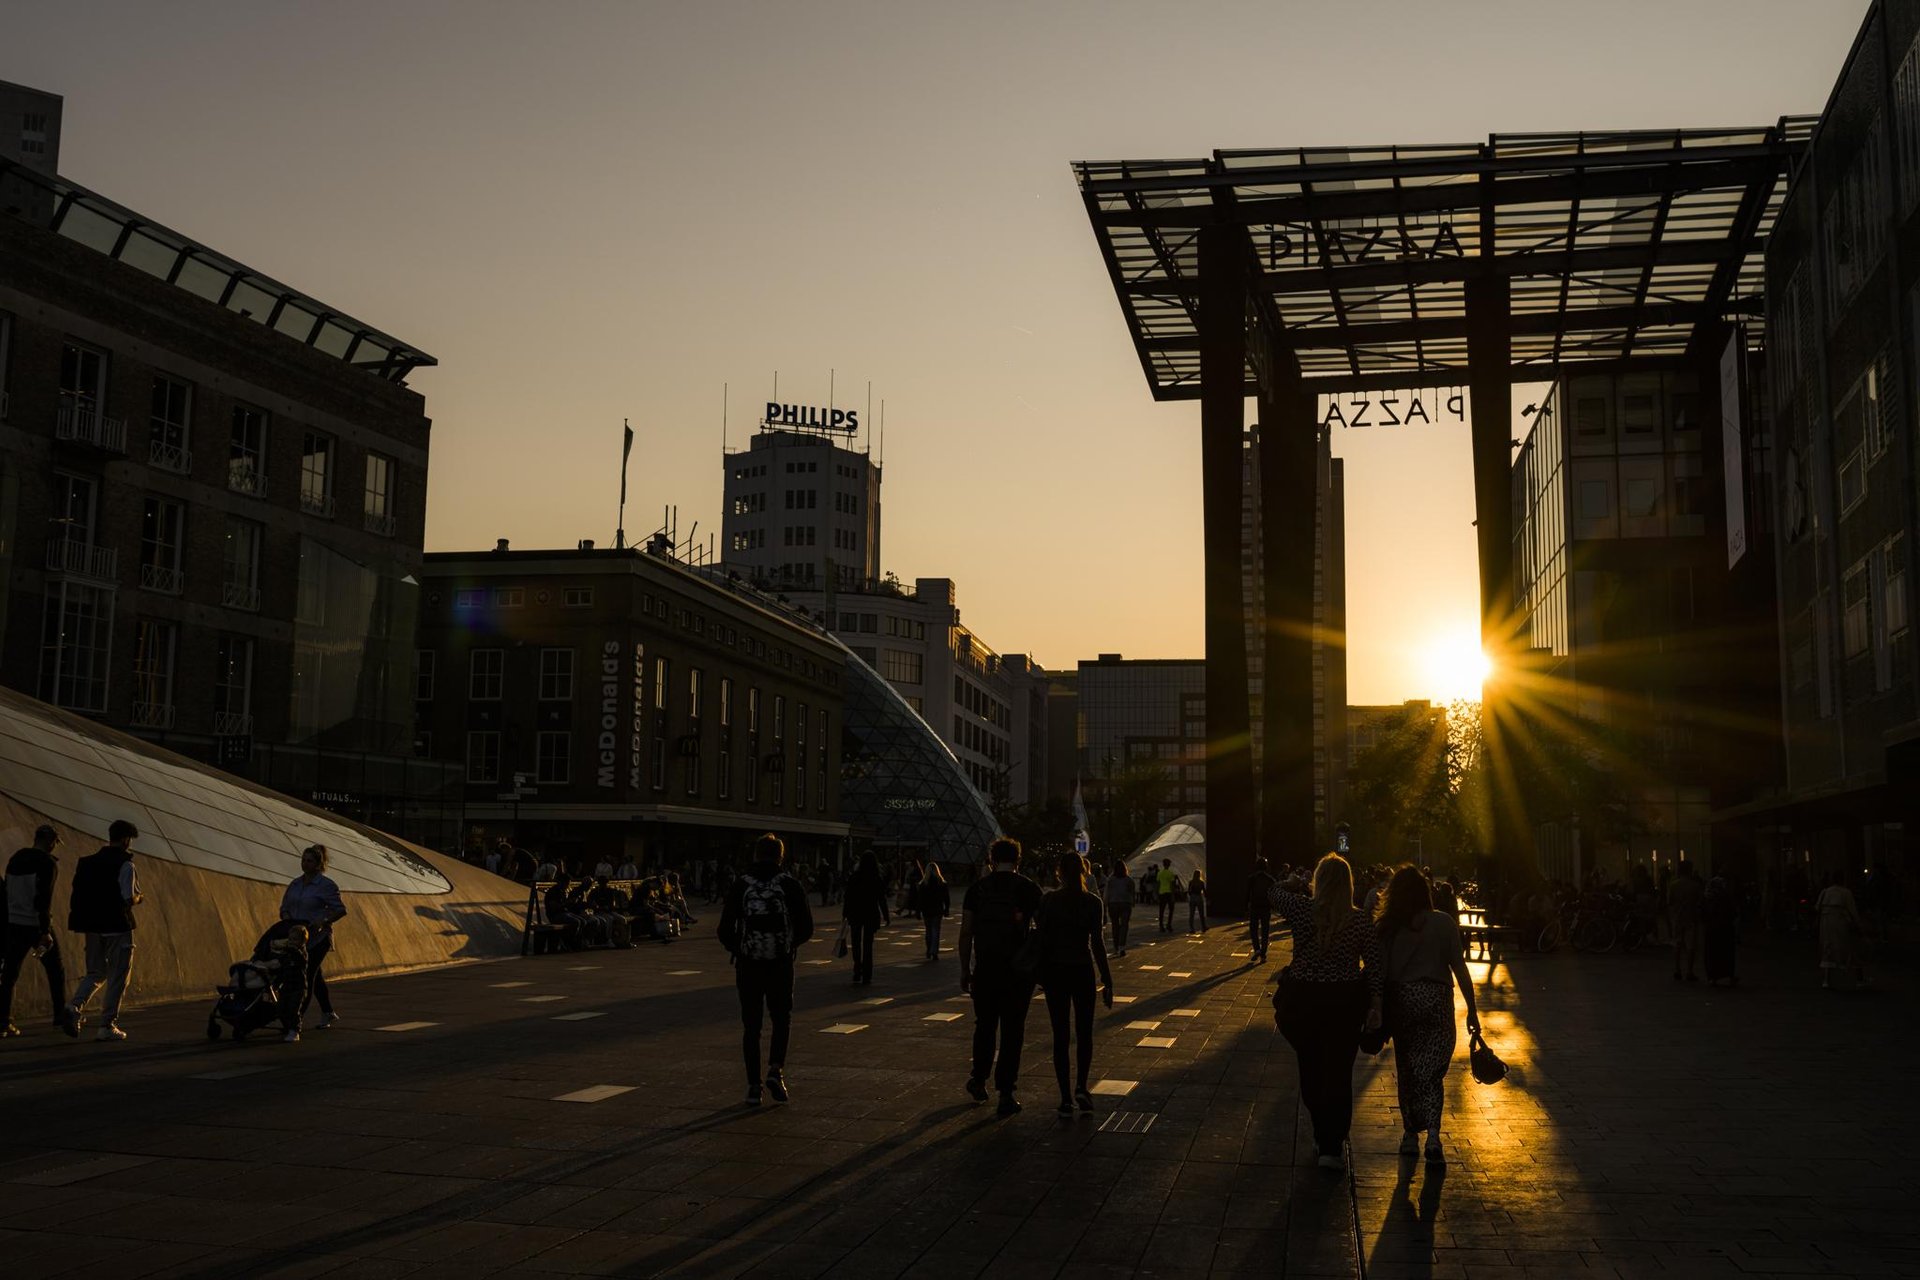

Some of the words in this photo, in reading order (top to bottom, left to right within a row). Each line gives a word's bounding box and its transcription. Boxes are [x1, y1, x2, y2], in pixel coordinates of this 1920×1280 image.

[1270, 222, 1464, 270] PIAZZA
[766, 402, 858, 430] PHILIPS
[597, 640, 620, 788] McDonald's
[629, 642, 645, 789] McDonald's
